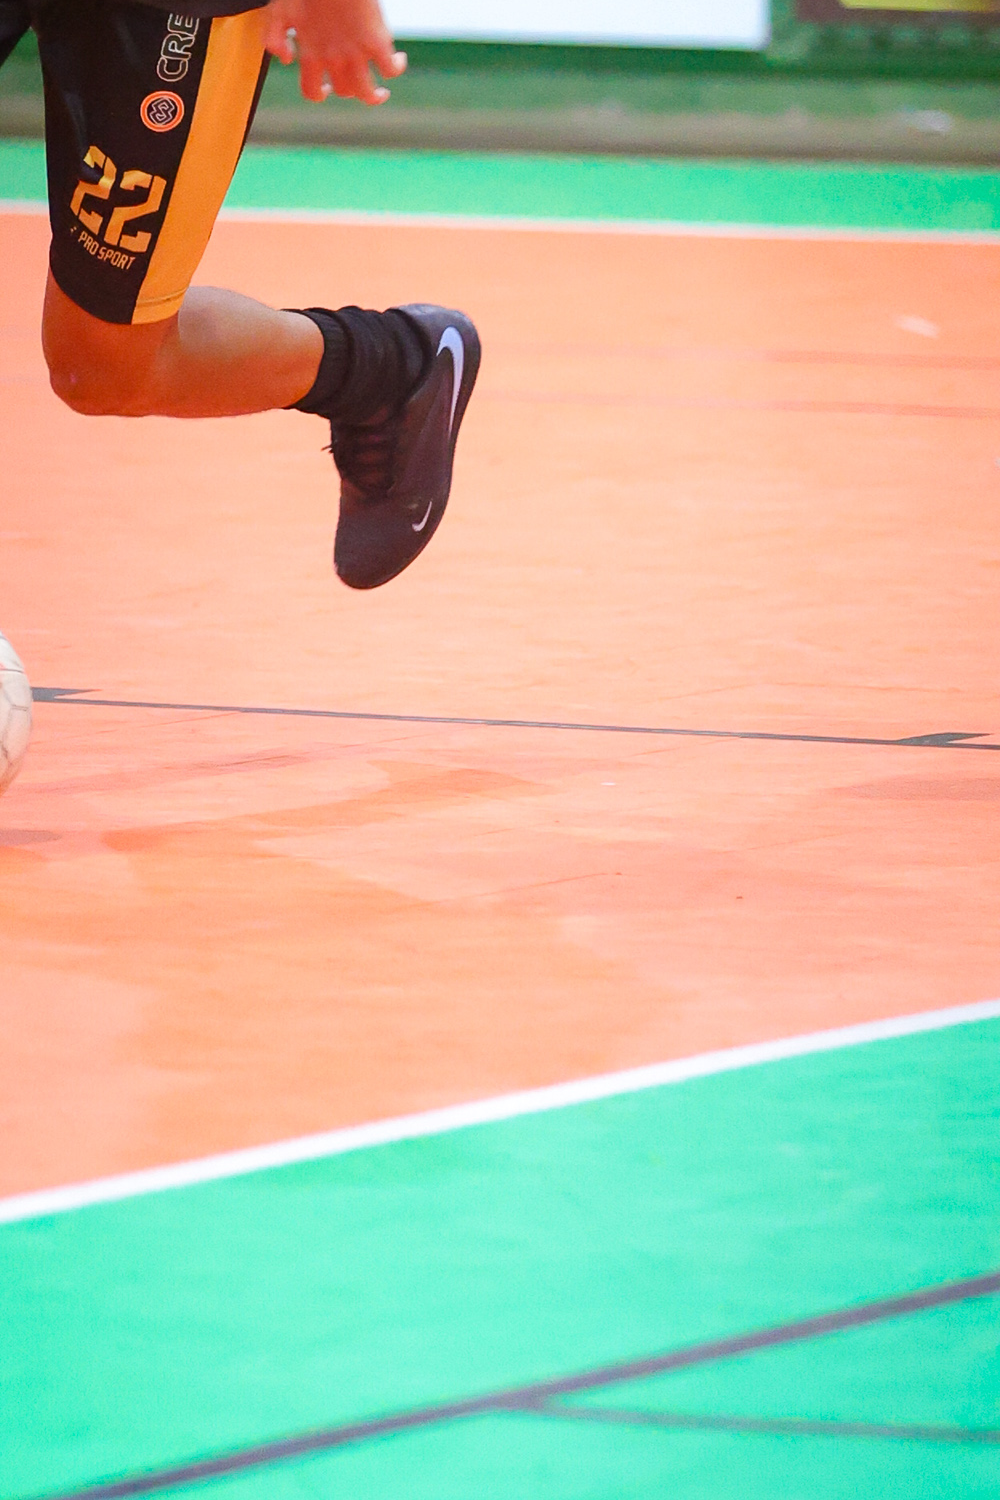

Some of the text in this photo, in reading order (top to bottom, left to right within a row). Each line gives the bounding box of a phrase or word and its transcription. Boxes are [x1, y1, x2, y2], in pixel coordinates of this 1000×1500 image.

[69, 145, 168, 254] 22
[77, 230, 136, 270] PRO SPORT
